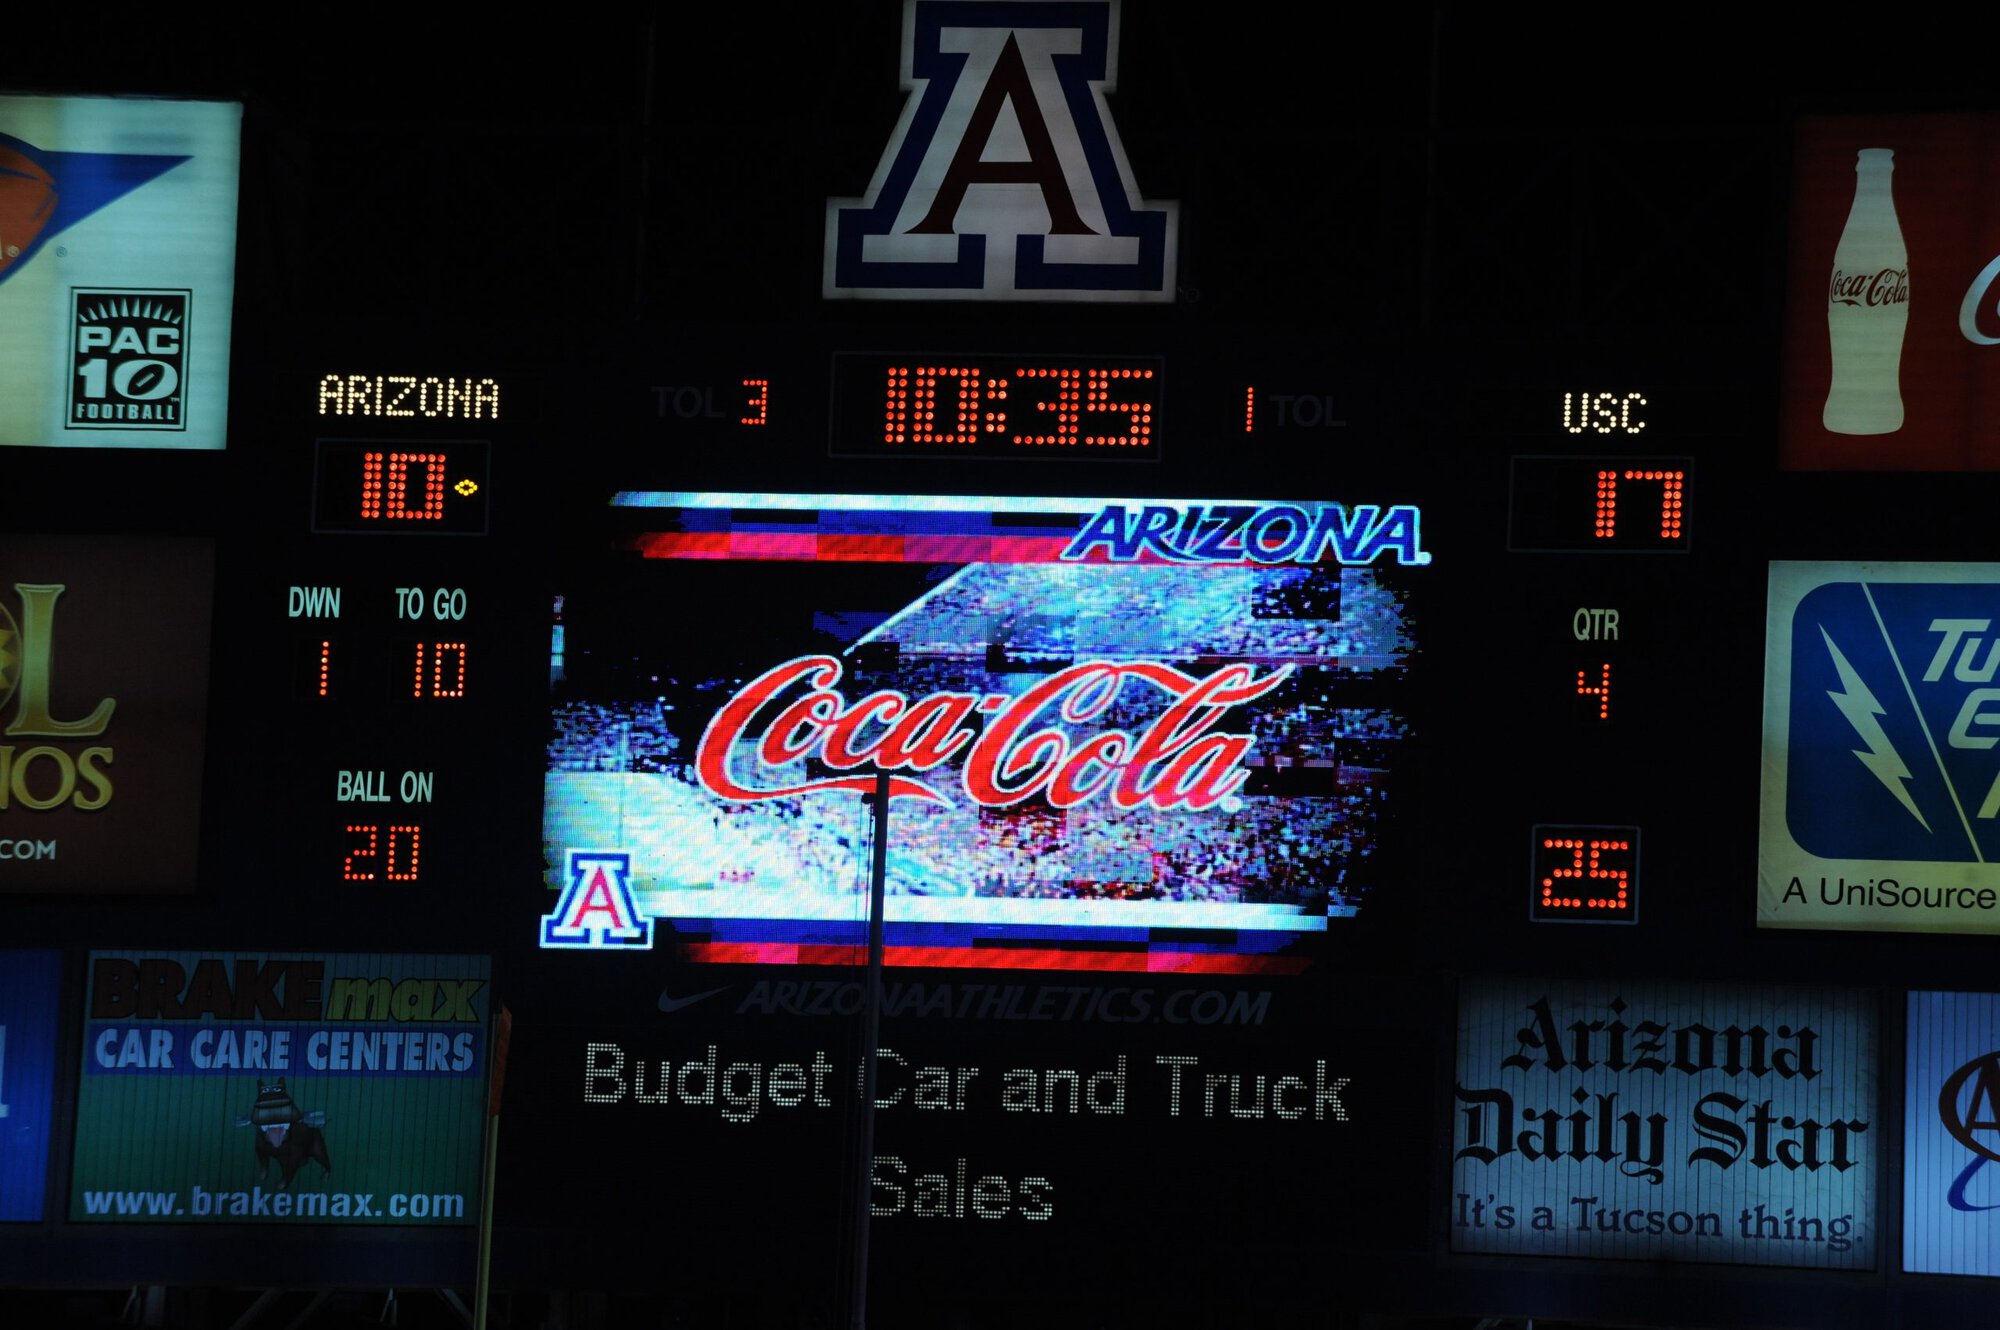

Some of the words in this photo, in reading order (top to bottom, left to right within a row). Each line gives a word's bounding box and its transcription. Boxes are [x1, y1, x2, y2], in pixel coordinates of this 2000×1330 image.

[822, 0, 1182, 302] A
[1830, 268, 1908, 307] Coca-Cola
[77, 325, 180, 355] PAC
[77, 357, 179, 400] 10
[319, 374, 499, 419] ARIZONA
[650, 386, 728, 420] TOL
[741, 379, 770, 426] 3
[75, 402, 176, 420] FOOTBALL
[884, 366, 1155, 447] 10:35
[1244, 385, 1256, 434] 1
[1269, 394, 1346, 429] TOL
[1563, 392, 1647, 434] USC
[361, 452, 446, 519] 10
[1595, 470, 1684, 538] 17
[1058, 504, 1424, 566] ARIZONA
[288, 586, 341, 618] DWN
[395, 587, 424, 619] TO
[432, 588, 468, 620] GO
[1572, 607, 1620, 641] QTR
[316, 640, 331, 698] 1
[412, 641, 467, 698] 10
[1577, 663, 1611, 721] 4
[694, 654, 1297, 811] Coca-Cola
[336, 769, 392, 802] BALL
[400, 770, 434, 804] ON
[342, 825, 421, 882] 20
[1541, 839, 1630, 911] 25
[539, 849, 654, 950] A
[1783, 876, 1807, 904] A
[1820, 877, 1998, 909] UniSource
[91, 957, 326, 1021] BRAKE
[326, 977, 488, 1023] max
[736, 979, 1272, 1025] ARIZONAATHLETICS.COM
[95, 1028, 175, 1069] CAR
[190, 1030, 291, 1071] CARE
[306, 1030, 475, 1073] CENTERS
[1500, 996, 1823, 1082] Arizona
[583, 1042, 834, 1123] Budget
[857, 1047, 980, 1112] Car
[1002, 1054, 1127, 1116] and
[1155, 1055, 1352, 1122] Truck
[1454, 1082, 1668, 1186] Daily
[1688, 1091, 1870, 1174] Star
[83, 1185, 465, 1220] www.brakemax.com
[869, 1155, 1055, 1222] Sales
[1455, 1193, 1516, 1230] It's
[1531, 1206, 1555, 1231] a
[1570, 1196, 1723, 1237] Tucson
[1738, 1203, 1865, 1253] thing.
